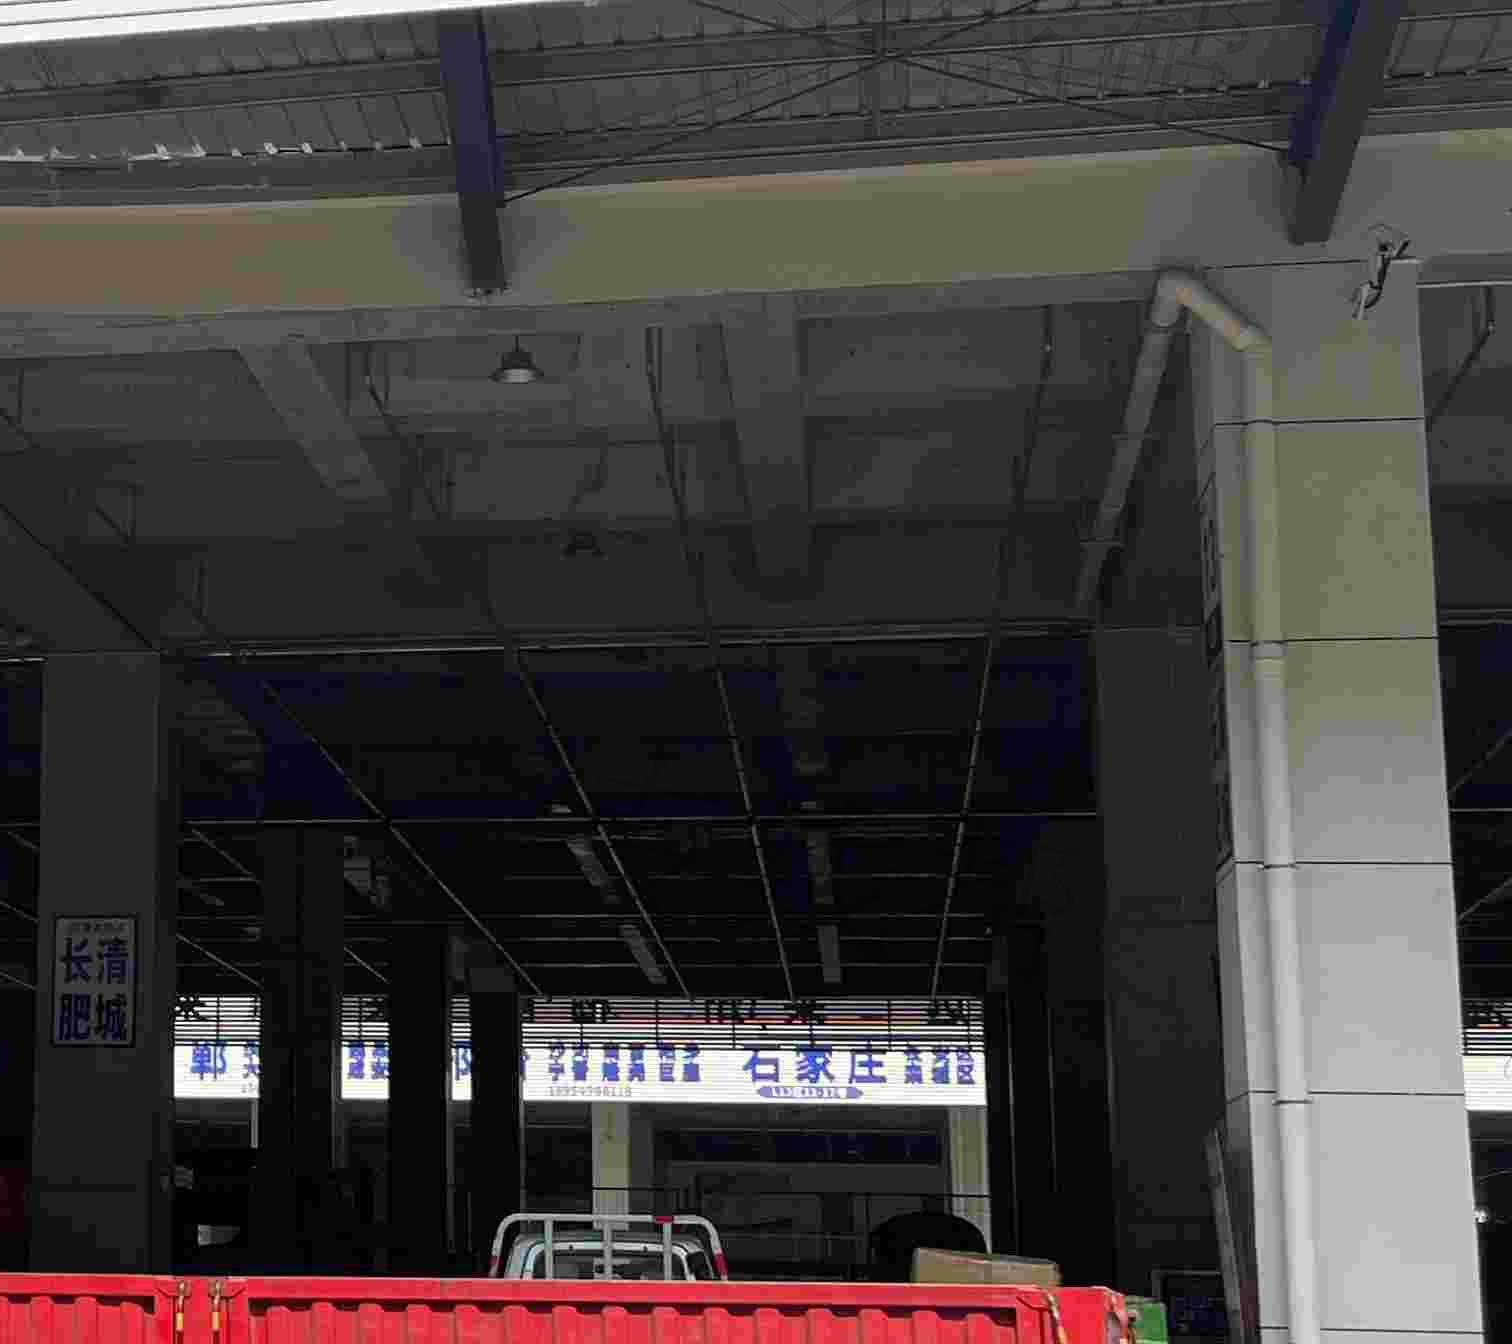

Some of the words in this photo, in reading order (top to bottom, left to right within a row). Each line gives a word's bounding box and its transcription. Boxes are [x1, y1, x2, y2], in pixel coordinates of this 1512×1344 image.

[59, 937, 129, 985] 长清
[58, 993, 128, 1042] 肥城
[742, 1042, 888, 1085] 石家庄
